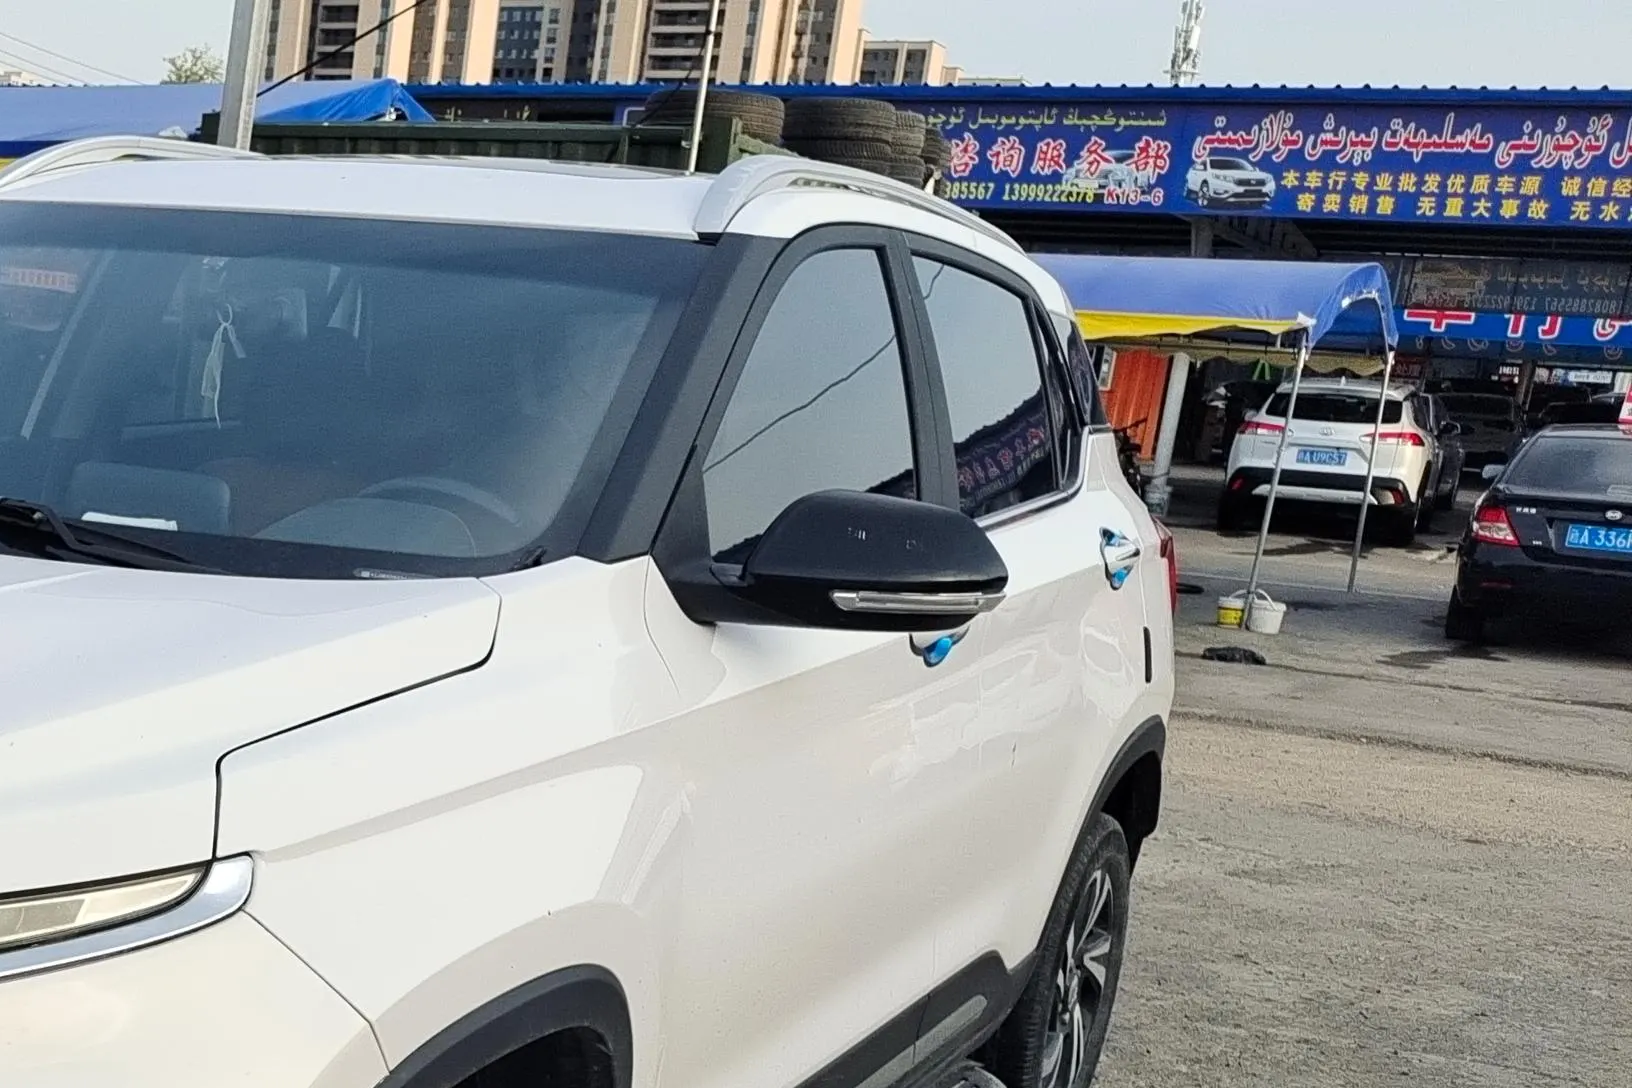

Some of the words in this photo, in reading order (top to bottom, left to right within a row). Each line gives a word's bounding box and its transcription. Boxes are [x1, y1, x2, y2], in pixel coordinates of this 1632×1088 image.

[949, 132, 1171, 184] 咨询服务部
[1281, 168, 1542, 195] 本车行专业批发优质车源
[1416, 196, 1549, 220] 无重大事故
[1569, 201, 1632, 222] 无水
